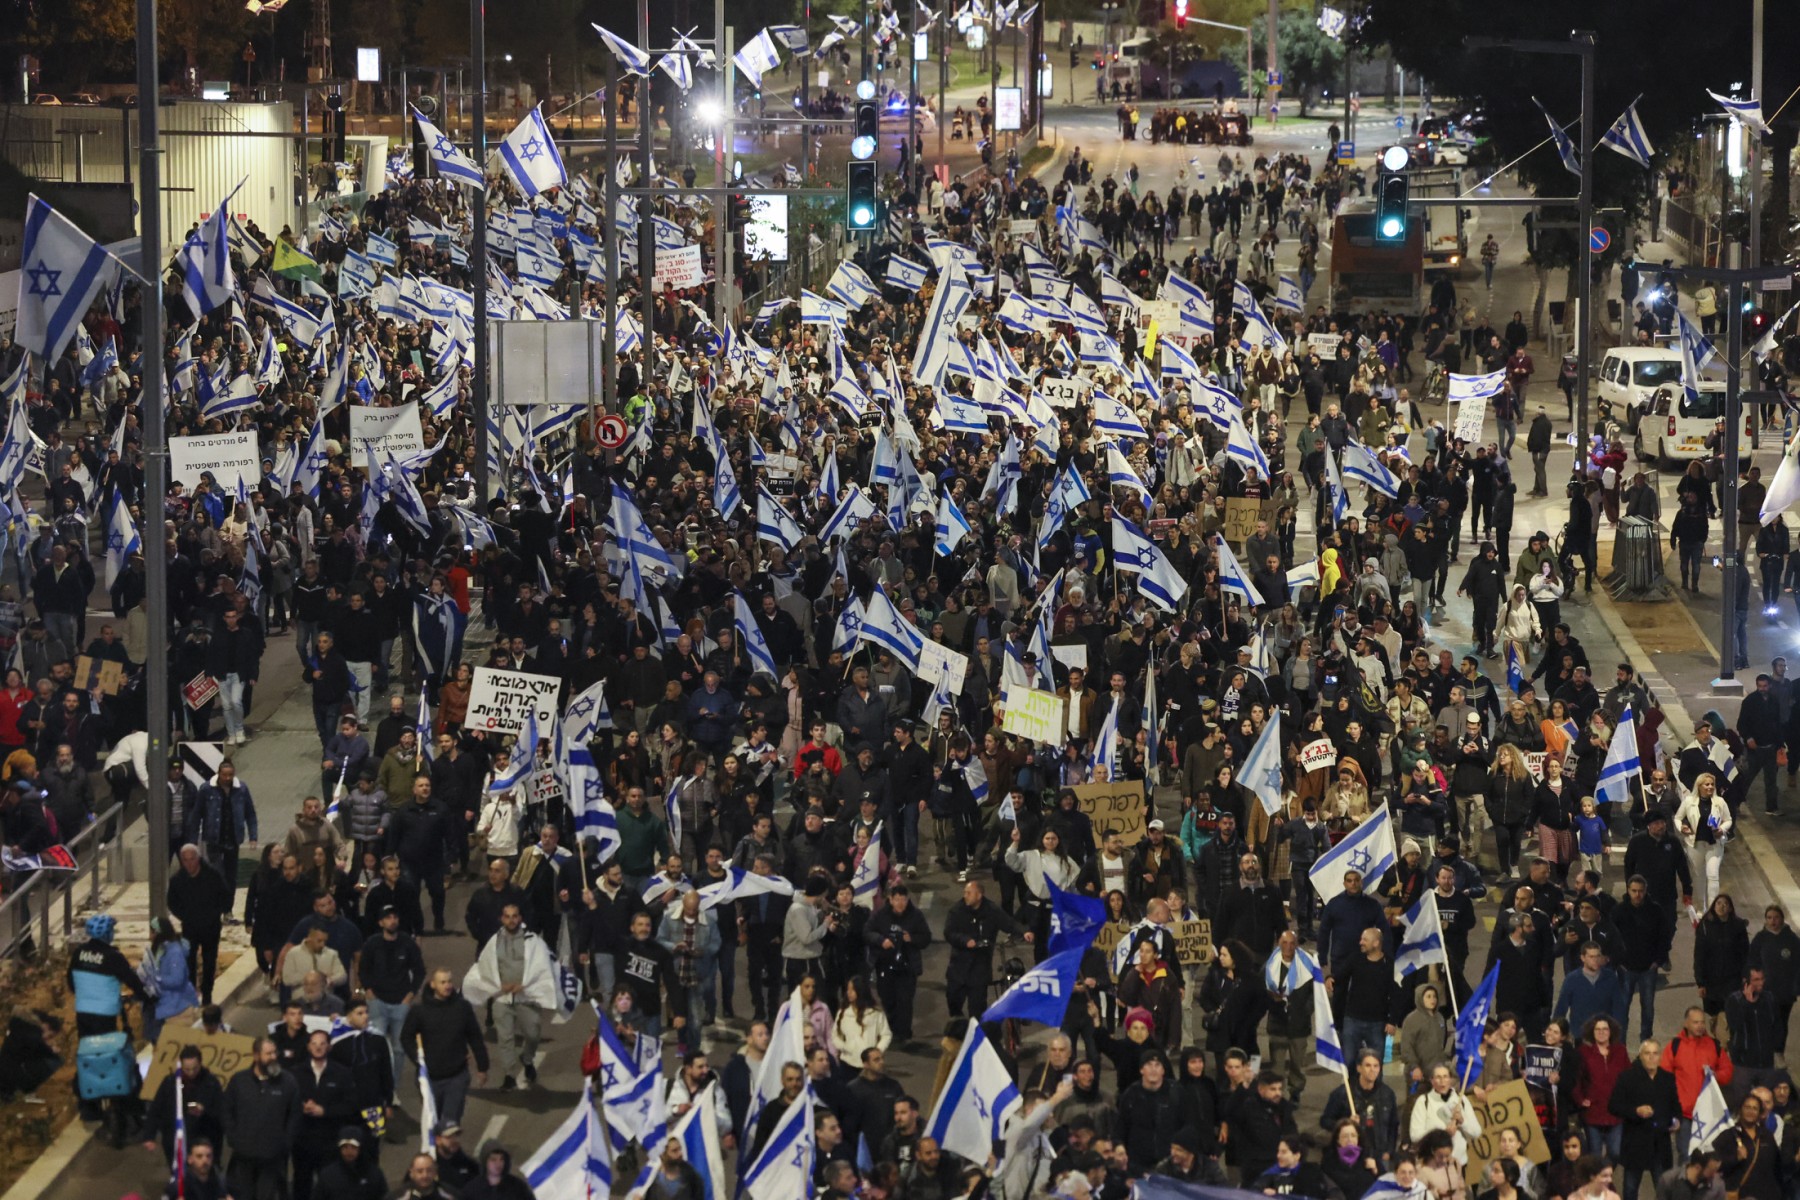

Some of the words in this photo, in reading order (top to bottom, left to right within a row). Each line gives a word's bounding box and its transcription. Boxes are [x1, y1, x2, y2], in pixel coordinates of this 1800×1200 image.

[380, 413, 400, 422] אהרון
[208, 438, 236, 446] מנדטים
[237, 436, 248, 444] 64
[185, 462, 220, 470] משפטית
[223, 458, 254, 467] רפורמה
[486, 675, 528, 689] מוצא:
[528, 681, 558, 695] ארץ
[494, 692, 538, 707] מרוקו
[1025, 692, 1057, 719] זהות
[472, 704, 511, 718] להיות
[1003, 708, 1049, 742] יהודית
[1305, 744, 1329, 759] בג"צ
